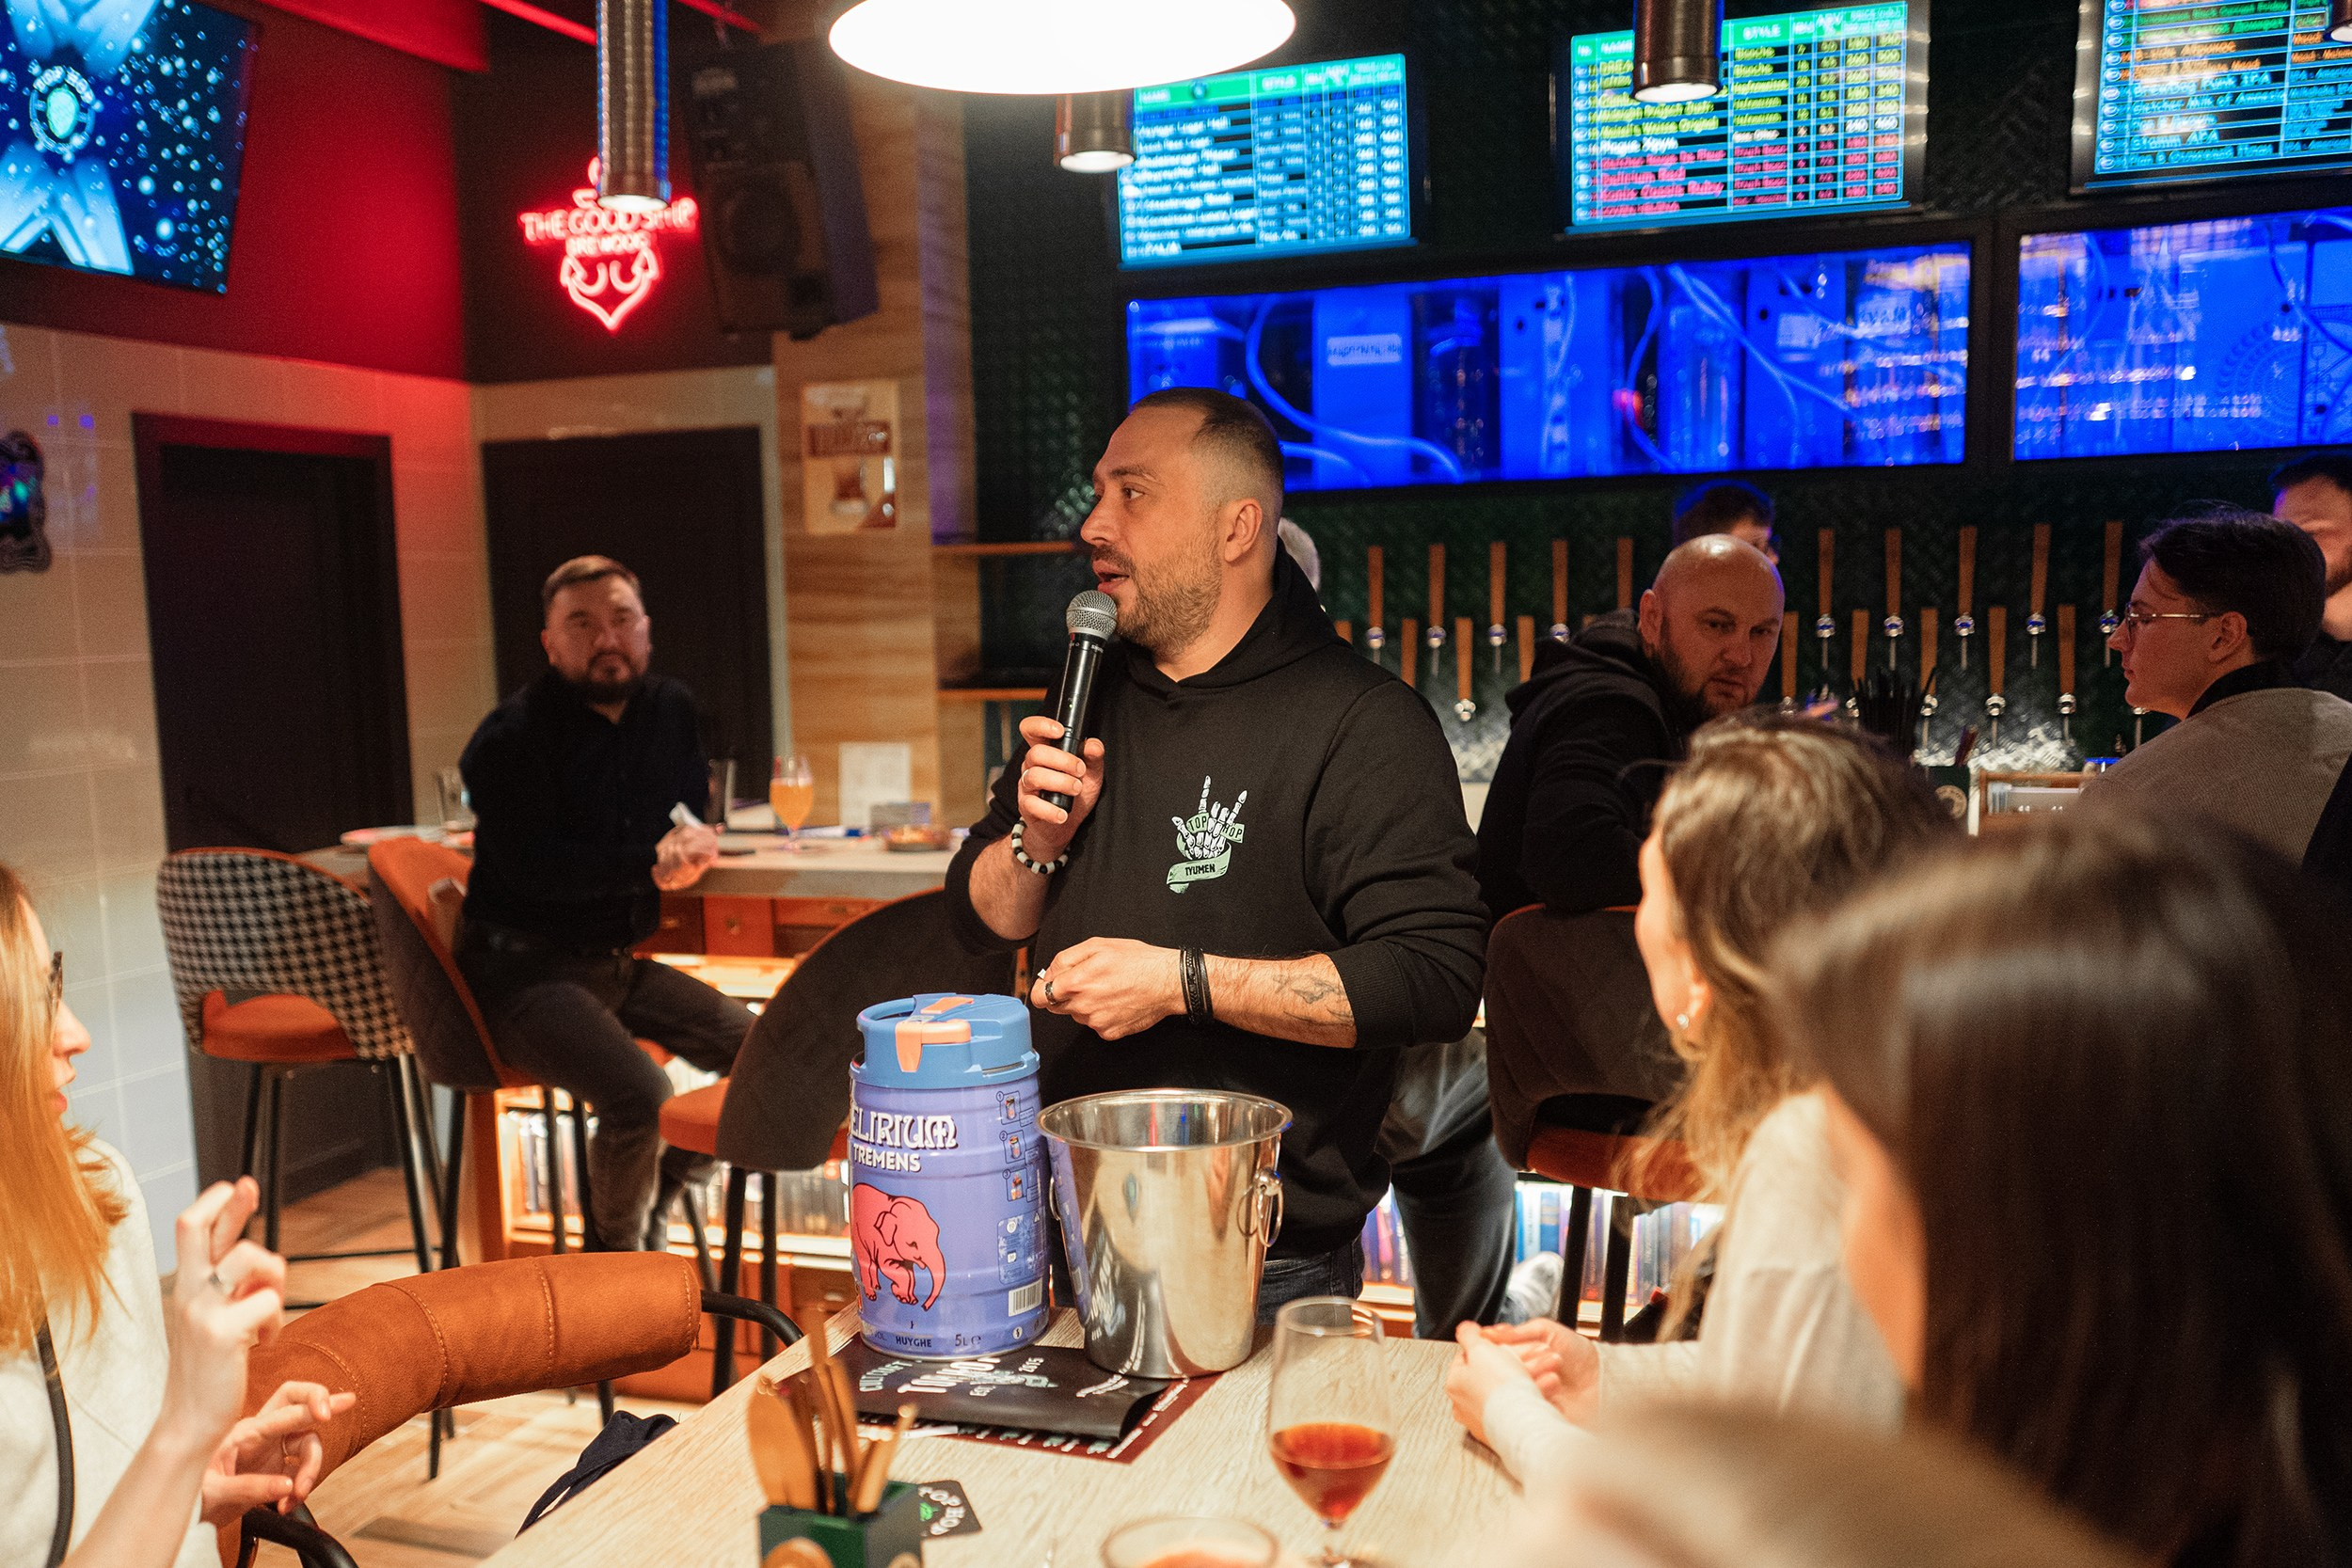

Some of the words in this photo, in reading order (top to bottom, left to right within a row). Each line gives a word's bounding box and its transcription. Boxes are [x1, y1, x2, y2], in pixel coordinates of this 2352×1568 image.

[1743, 24, 1781, 40] STYLE
[1658, 166, 1686, 181] Red
[520, 210, 567, 242] THE
[1188, 816, 1207, 831] TOP
[1223, 825, 1243, 839] HOP
[1185, 863, 1216, 876] TYUMEN
[850, 1107, 958, 1149] ELIRIUM
[853, 1143, 921, 1172] TREMENS
[896, 1336, 932, 1348] HUYGHE
